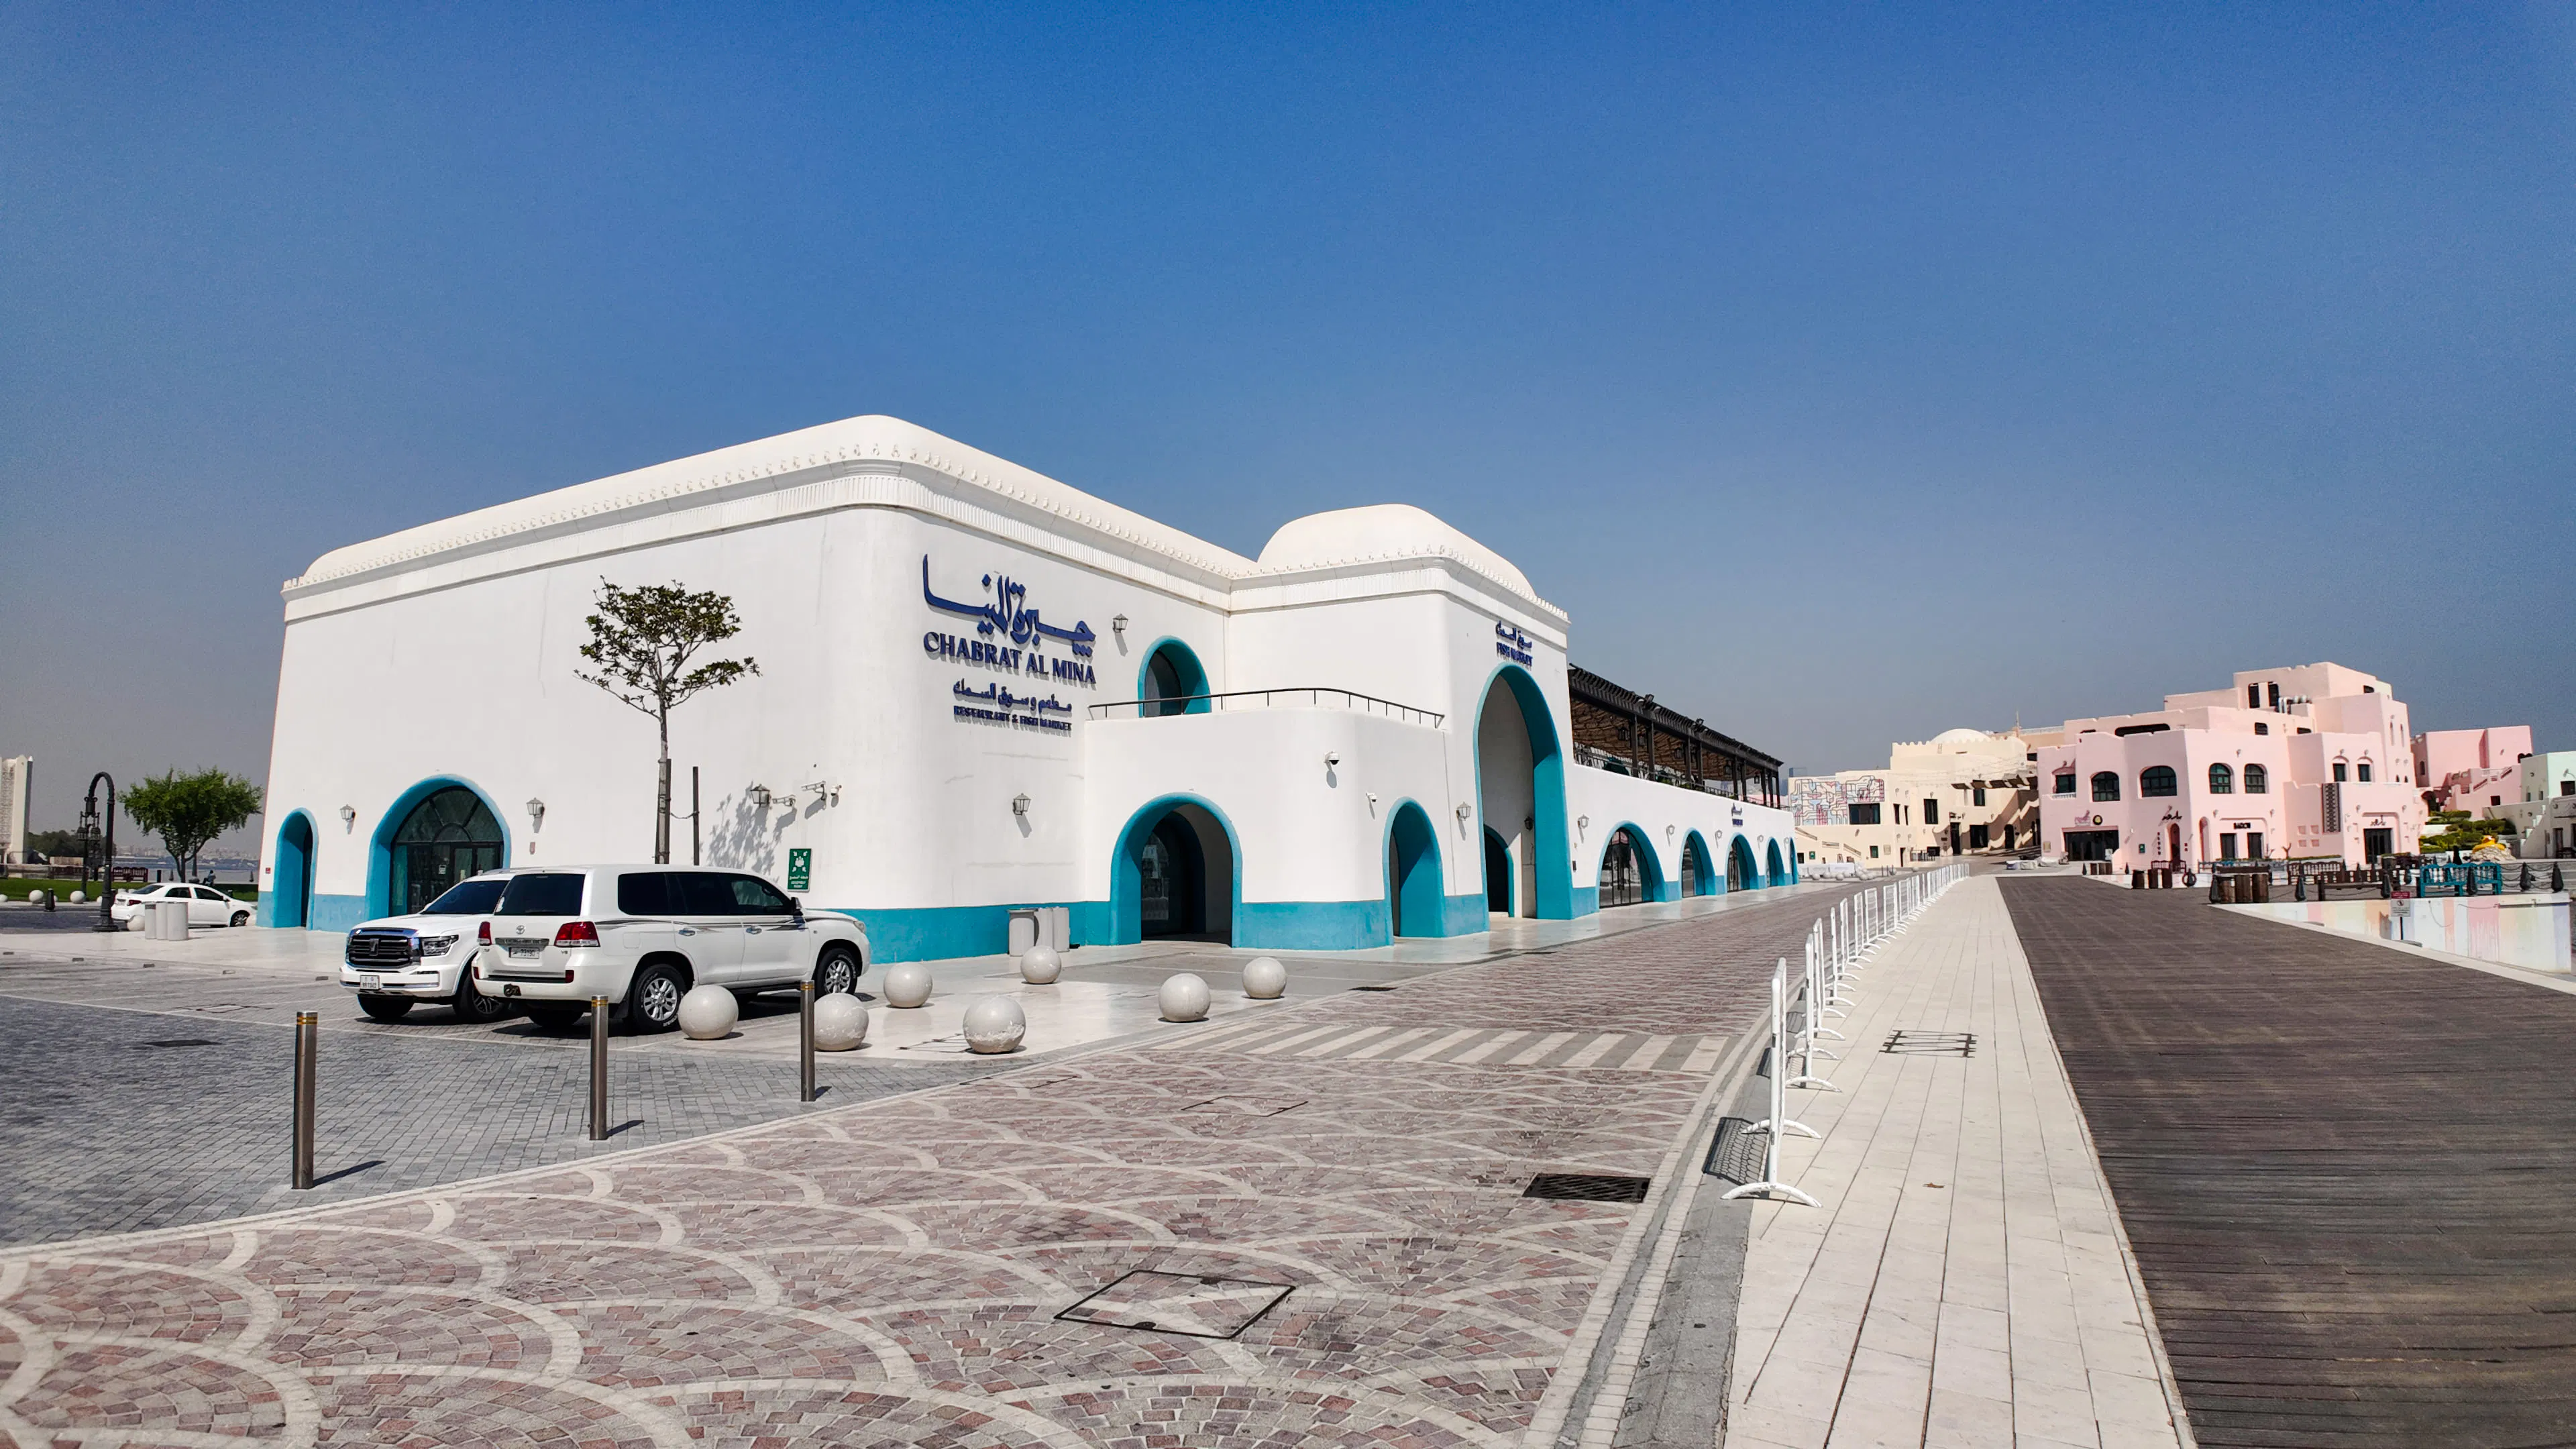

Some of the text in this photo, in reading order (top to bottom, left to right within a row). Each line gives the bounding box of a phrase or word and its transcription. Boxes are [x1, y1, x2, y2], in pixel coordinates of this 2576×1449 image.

[923, 631, 1097, 685] CHABRAT AL MINA
[953, 678, 996, 700] السمك
[998, 686, 1029, 708] سوق
[1038, 694, 1072, 714] مطعم
[953, 705, 1071, 731] RESTAURANT & FISH MARKET
